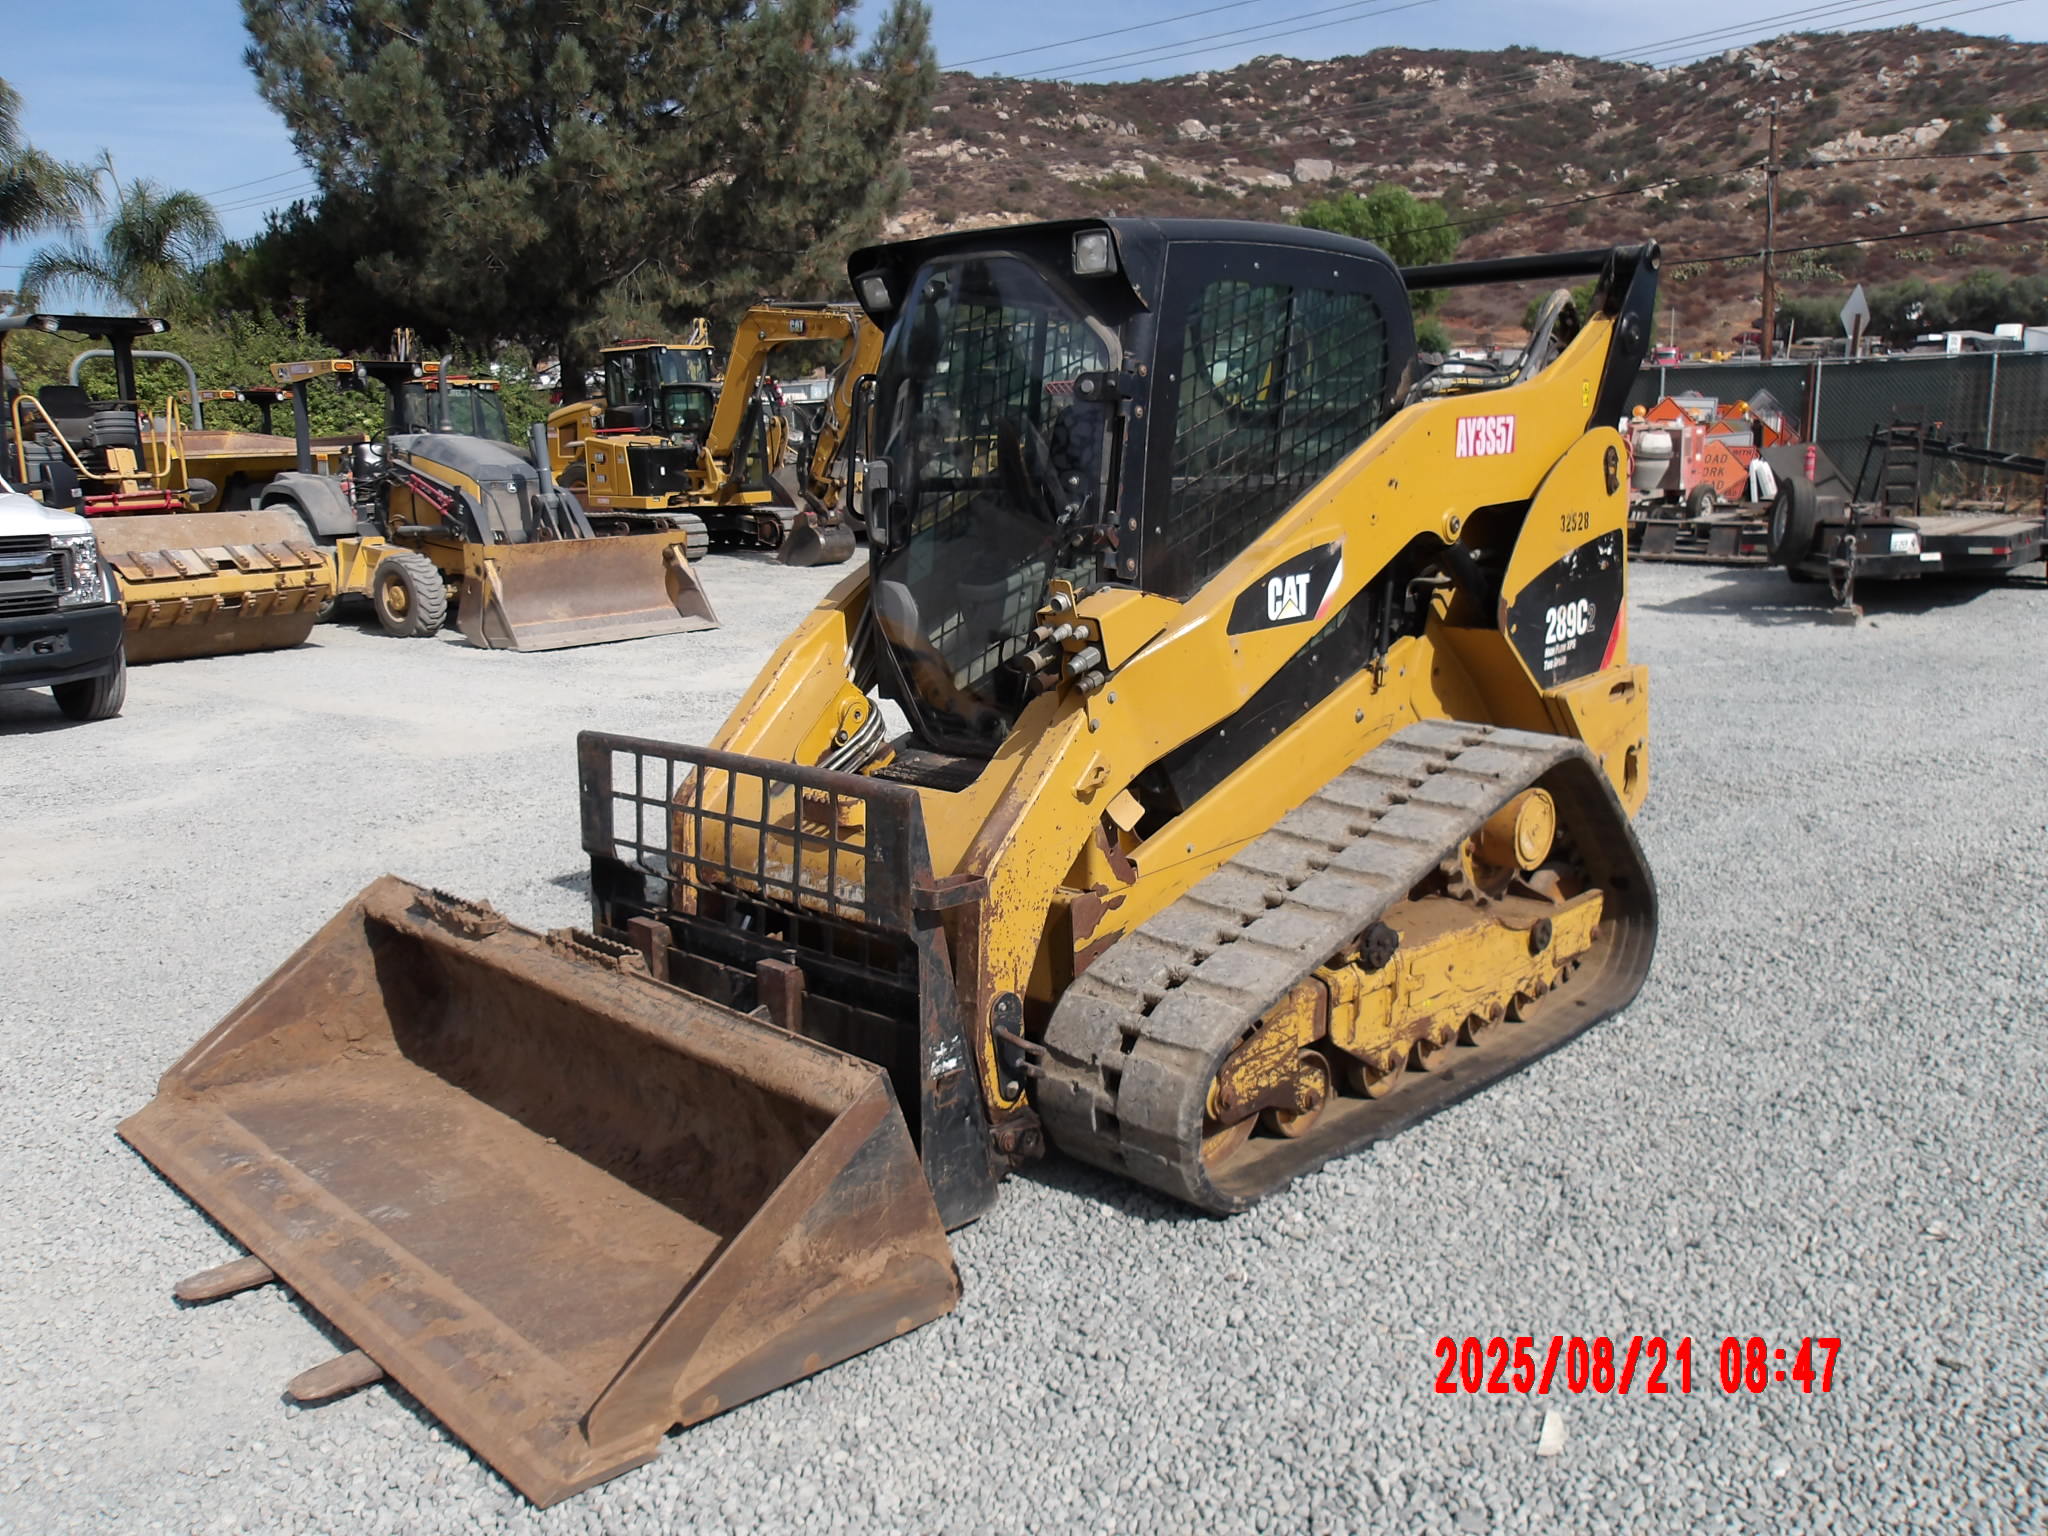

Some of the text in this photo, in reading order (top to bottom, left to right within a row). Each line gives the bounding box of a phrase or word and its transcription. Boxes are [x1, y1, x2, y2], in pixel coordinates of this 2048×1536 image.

[789, 319, 804, 334] CAT
[1456, 415, 1514, 458] AY3S57
[1704, 454, 1728, 464] OAD
[1703, 467, 1726, 477] ORK
[1267, 573, 1310, 621] CAT
